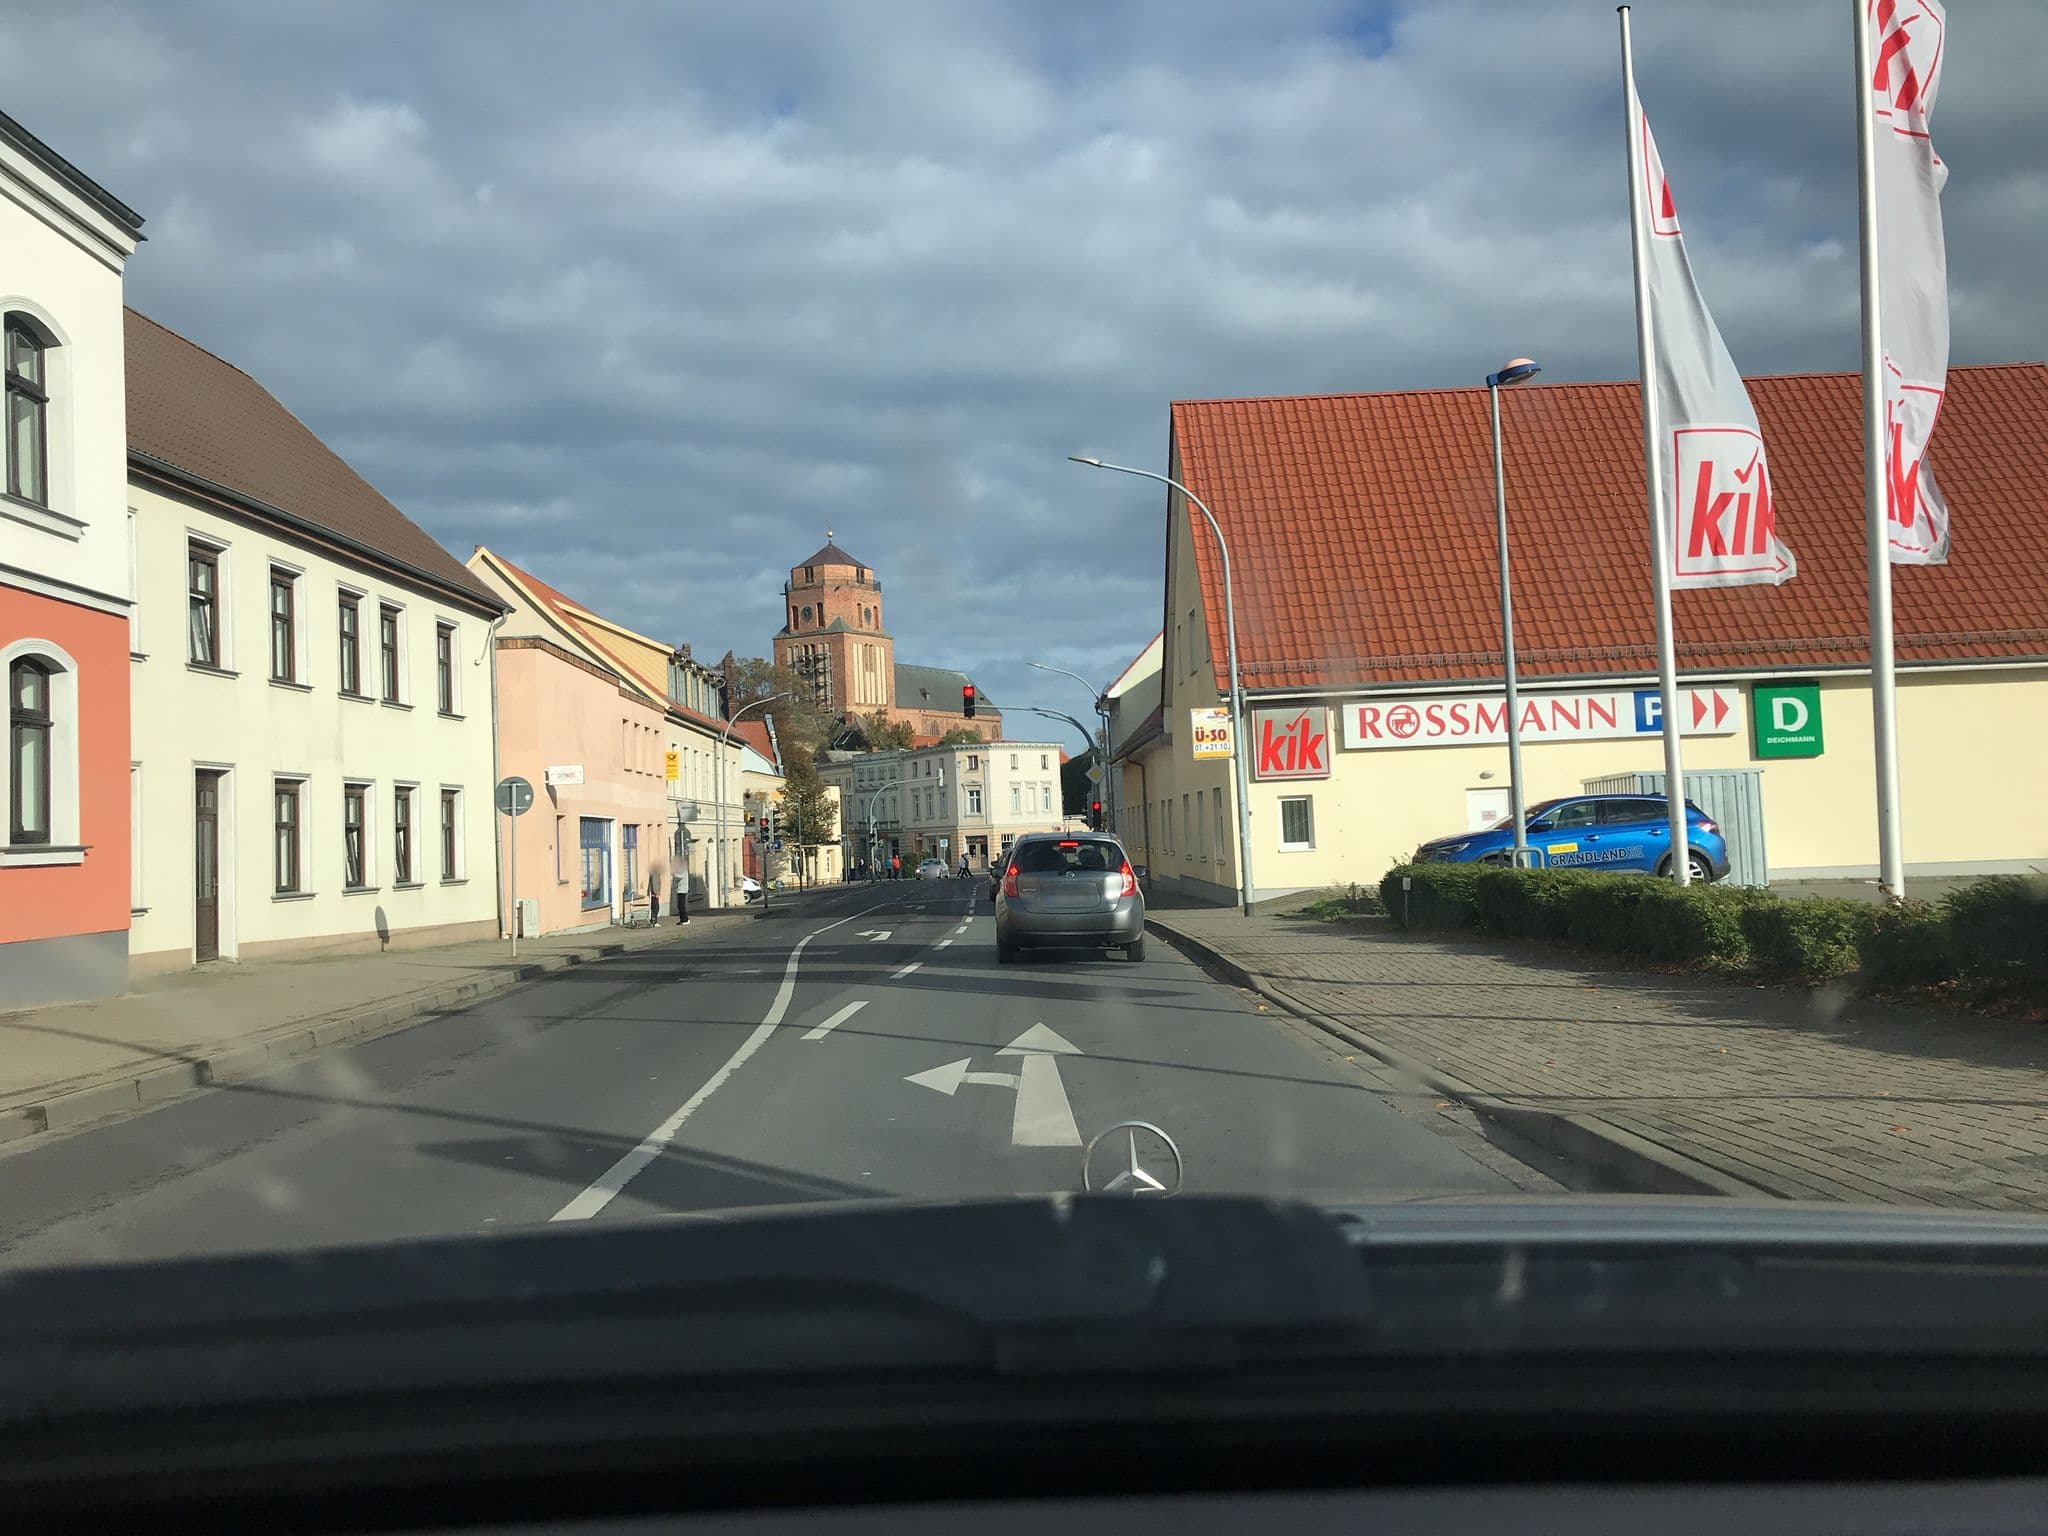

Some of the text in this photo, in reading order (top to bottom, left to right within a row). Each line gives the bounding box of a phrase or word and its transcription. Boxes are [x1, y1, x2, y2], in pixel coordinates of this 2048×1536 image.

[1359, 697, 1616, 739] ROSSMANN
[1195, 726, 1228, 743] Ü-30
[1260, 709, 1325, 772] kik
[1766, 735, 1816, 745] DEICHMANN
[1550, 848, 1627, 867] GRANDLAND
